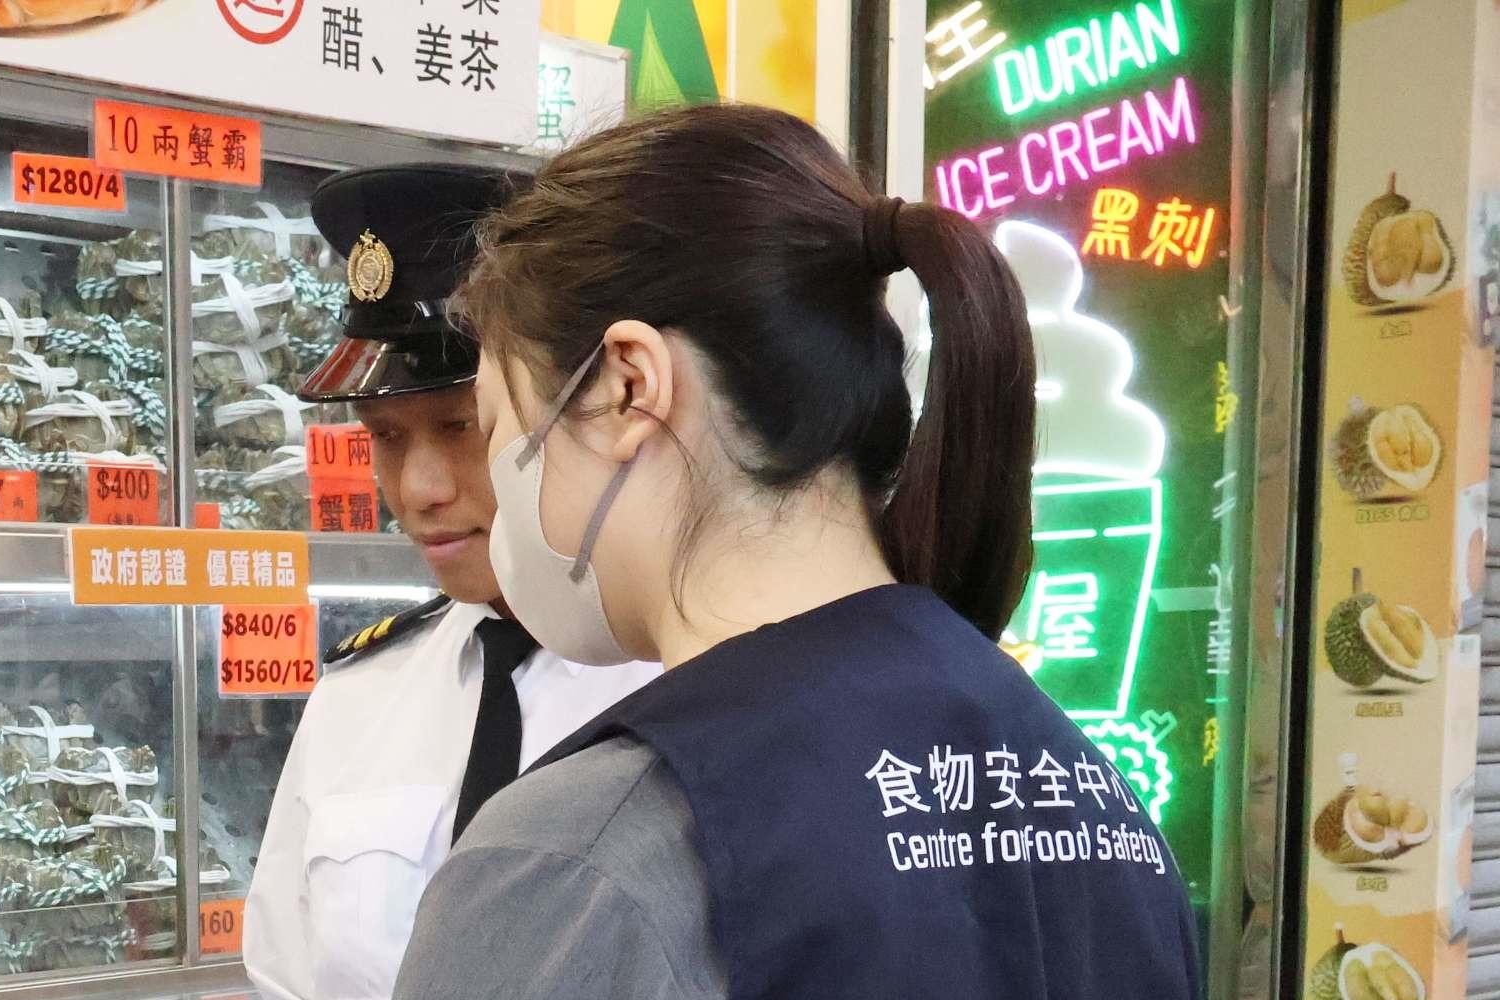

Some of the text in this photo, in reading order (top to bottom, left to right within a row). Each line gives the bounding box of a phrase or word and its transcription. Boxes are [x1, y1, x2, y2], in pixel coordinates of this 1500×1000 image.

[994, 0, 1181, 115] DURIAN
[108, 114, 140, 154] 10
[935, 77, 1196, 219] ICE CREAM
[21, 163, 120, 200] $1280/4
[1081, 187, 1215, 269] 黑刺
[310, 430, 336, 465] 10
[96, 468, 151, 502] $400
[90, 547, 297, 588] 政府認證 優質精品
[222, 612, 297, 640] $840/6
[221, 659, 315, 685] $1560/12
[864, 742, 1140, 818] 食物安全中心
[887, 828, 974, 872] Centre
[1024, 821, 1091, 864] Food
[1096, 822, 1166, 875] Safety
